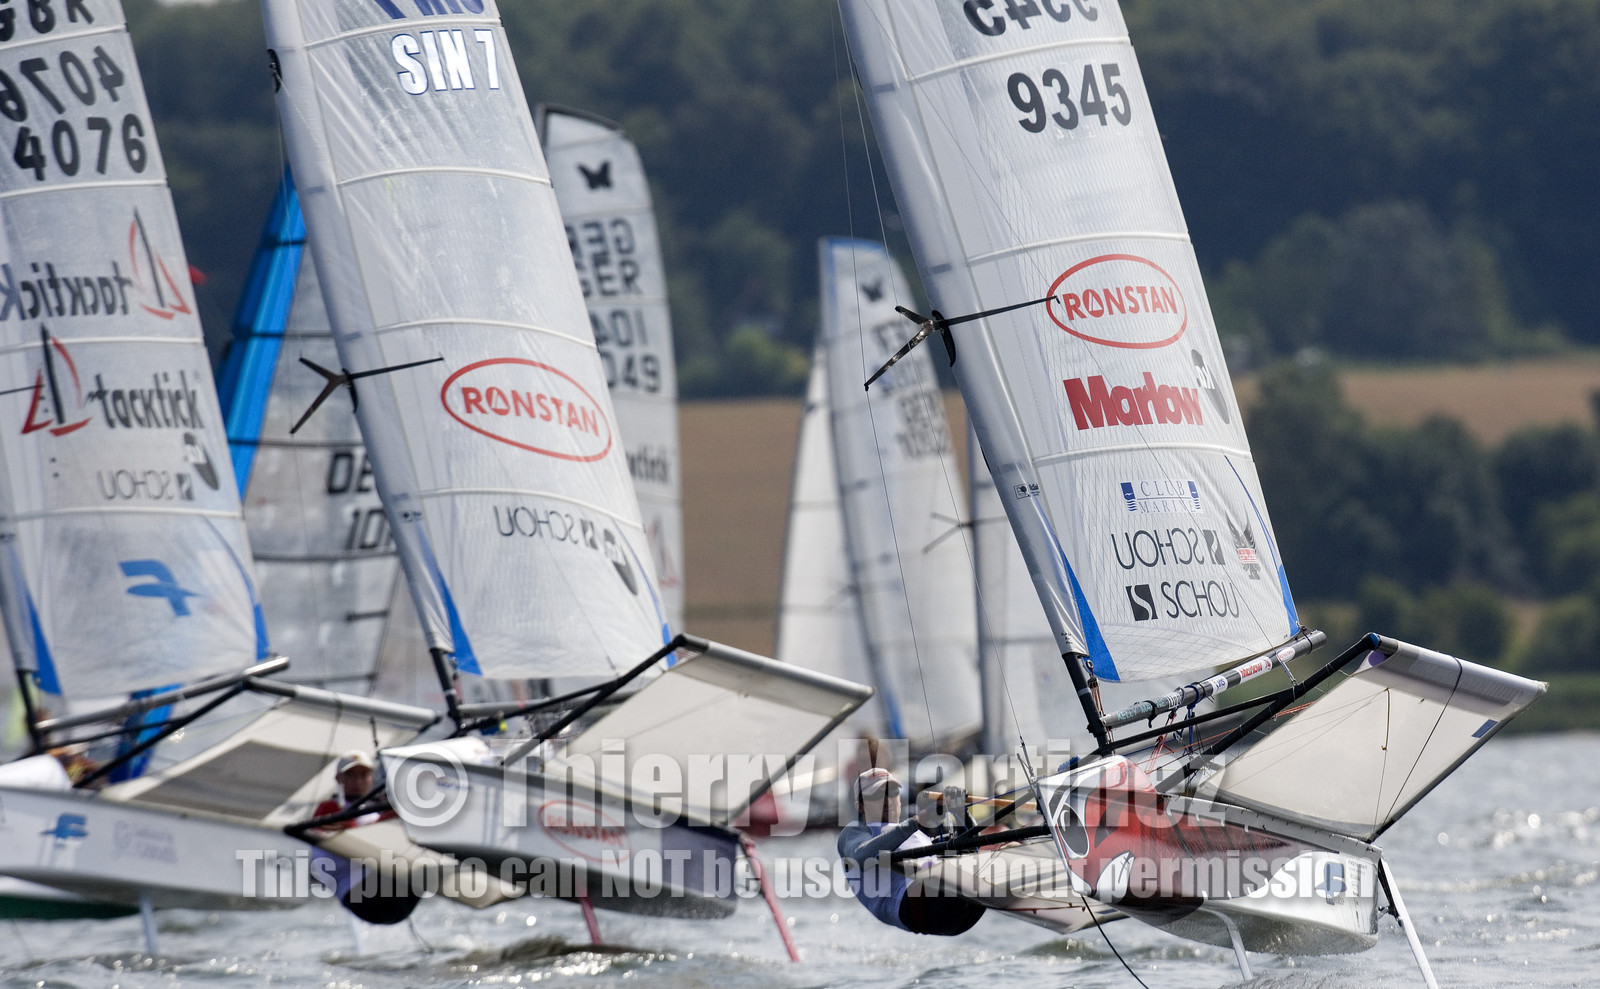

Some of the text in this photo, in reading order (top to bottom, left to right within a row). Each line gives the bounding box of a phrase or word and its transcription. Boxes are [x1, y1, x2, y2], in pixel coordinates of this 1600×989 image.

[390, 29, 500, 95] SIN 7
[1007, 63, 1131, 133] 9345
[14, 114, 147, 180] 4076
[1062, 285, 1178, 321] RONSTAN
[84, 369, 205, 430] tacktick
[461, 386, 600, 437] RONSTAN
[1063, 372, 1203, 430] Marlow
[1138, 500, 1196, 514] MARINE
[1140, 480, 1185, 497] CLUB
[1160, 580, 1240, 619] SCHOU
